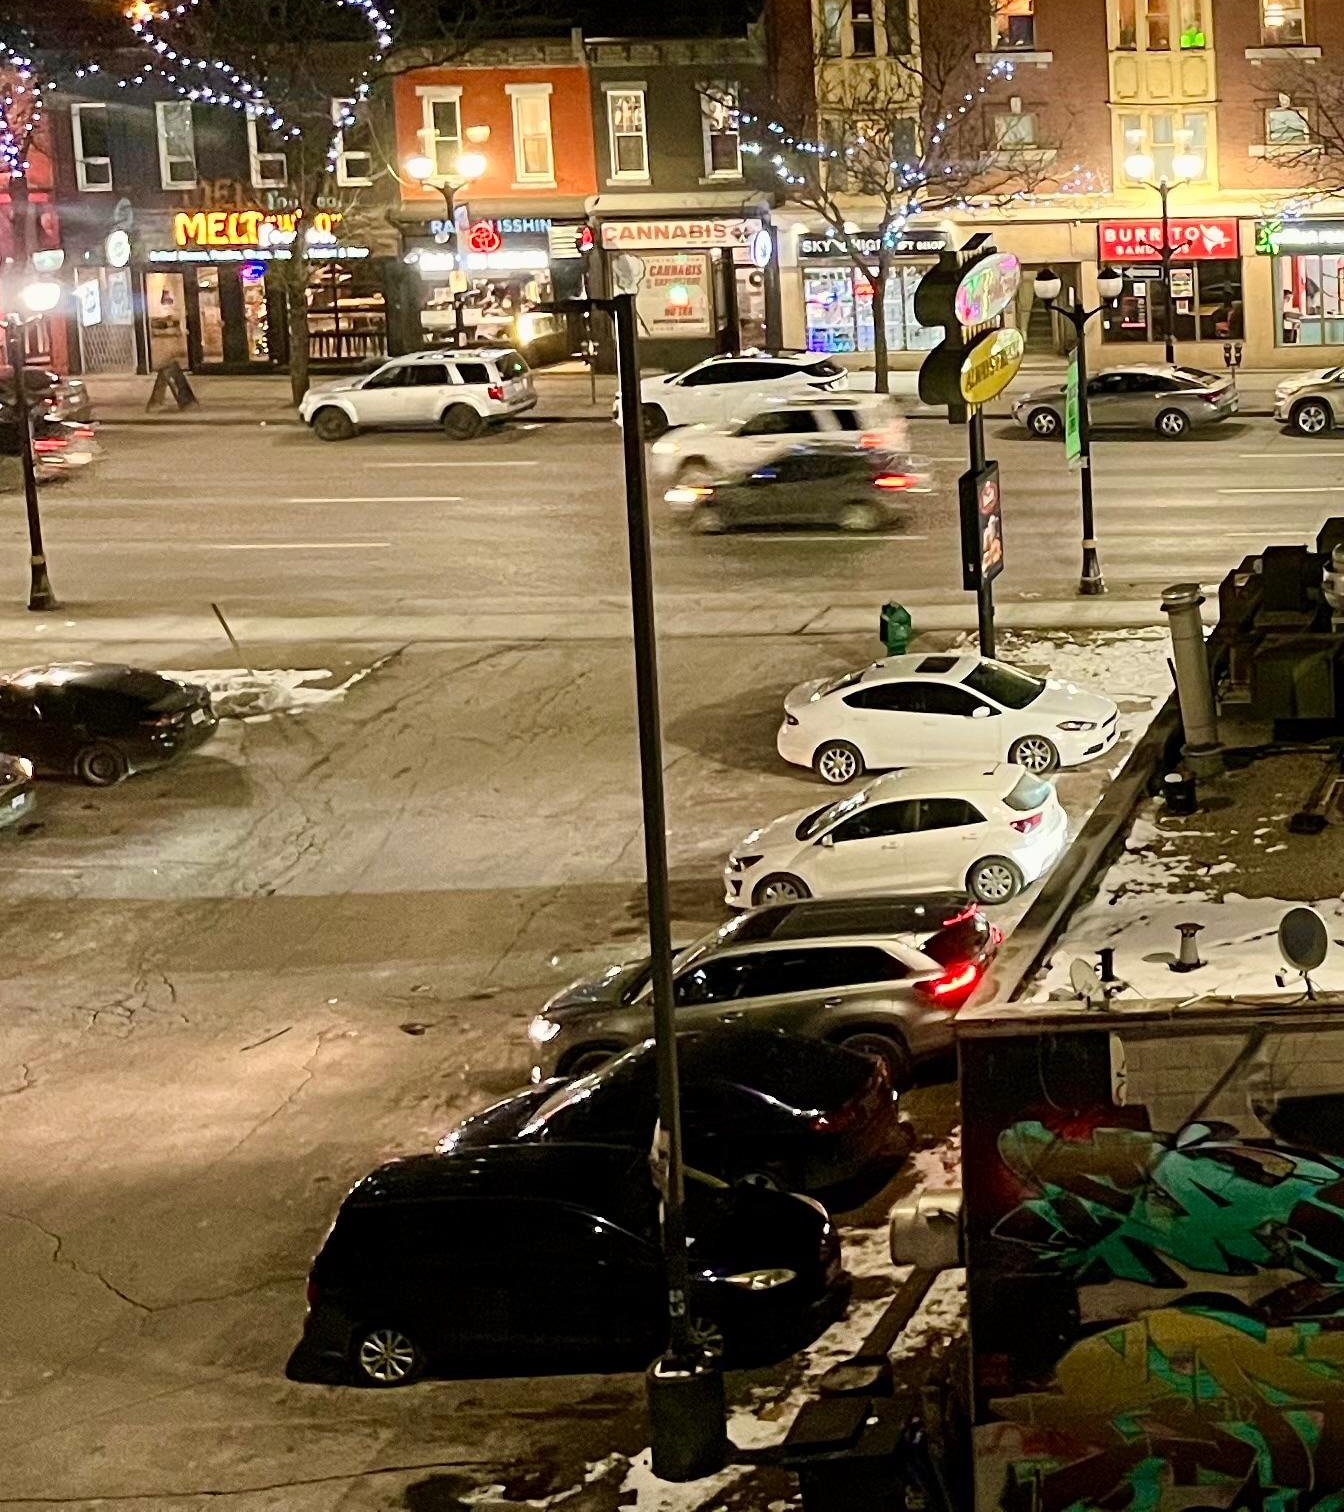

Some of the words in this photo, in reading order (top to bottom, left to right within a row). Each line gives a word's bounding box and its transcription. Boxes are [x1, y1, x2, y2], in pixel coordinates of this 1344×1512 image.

[603, 223, 727, 241] CANNABIS
[1104, 226, 1200, 243] BURRTO
[802, 240, 831, 253] SKY
